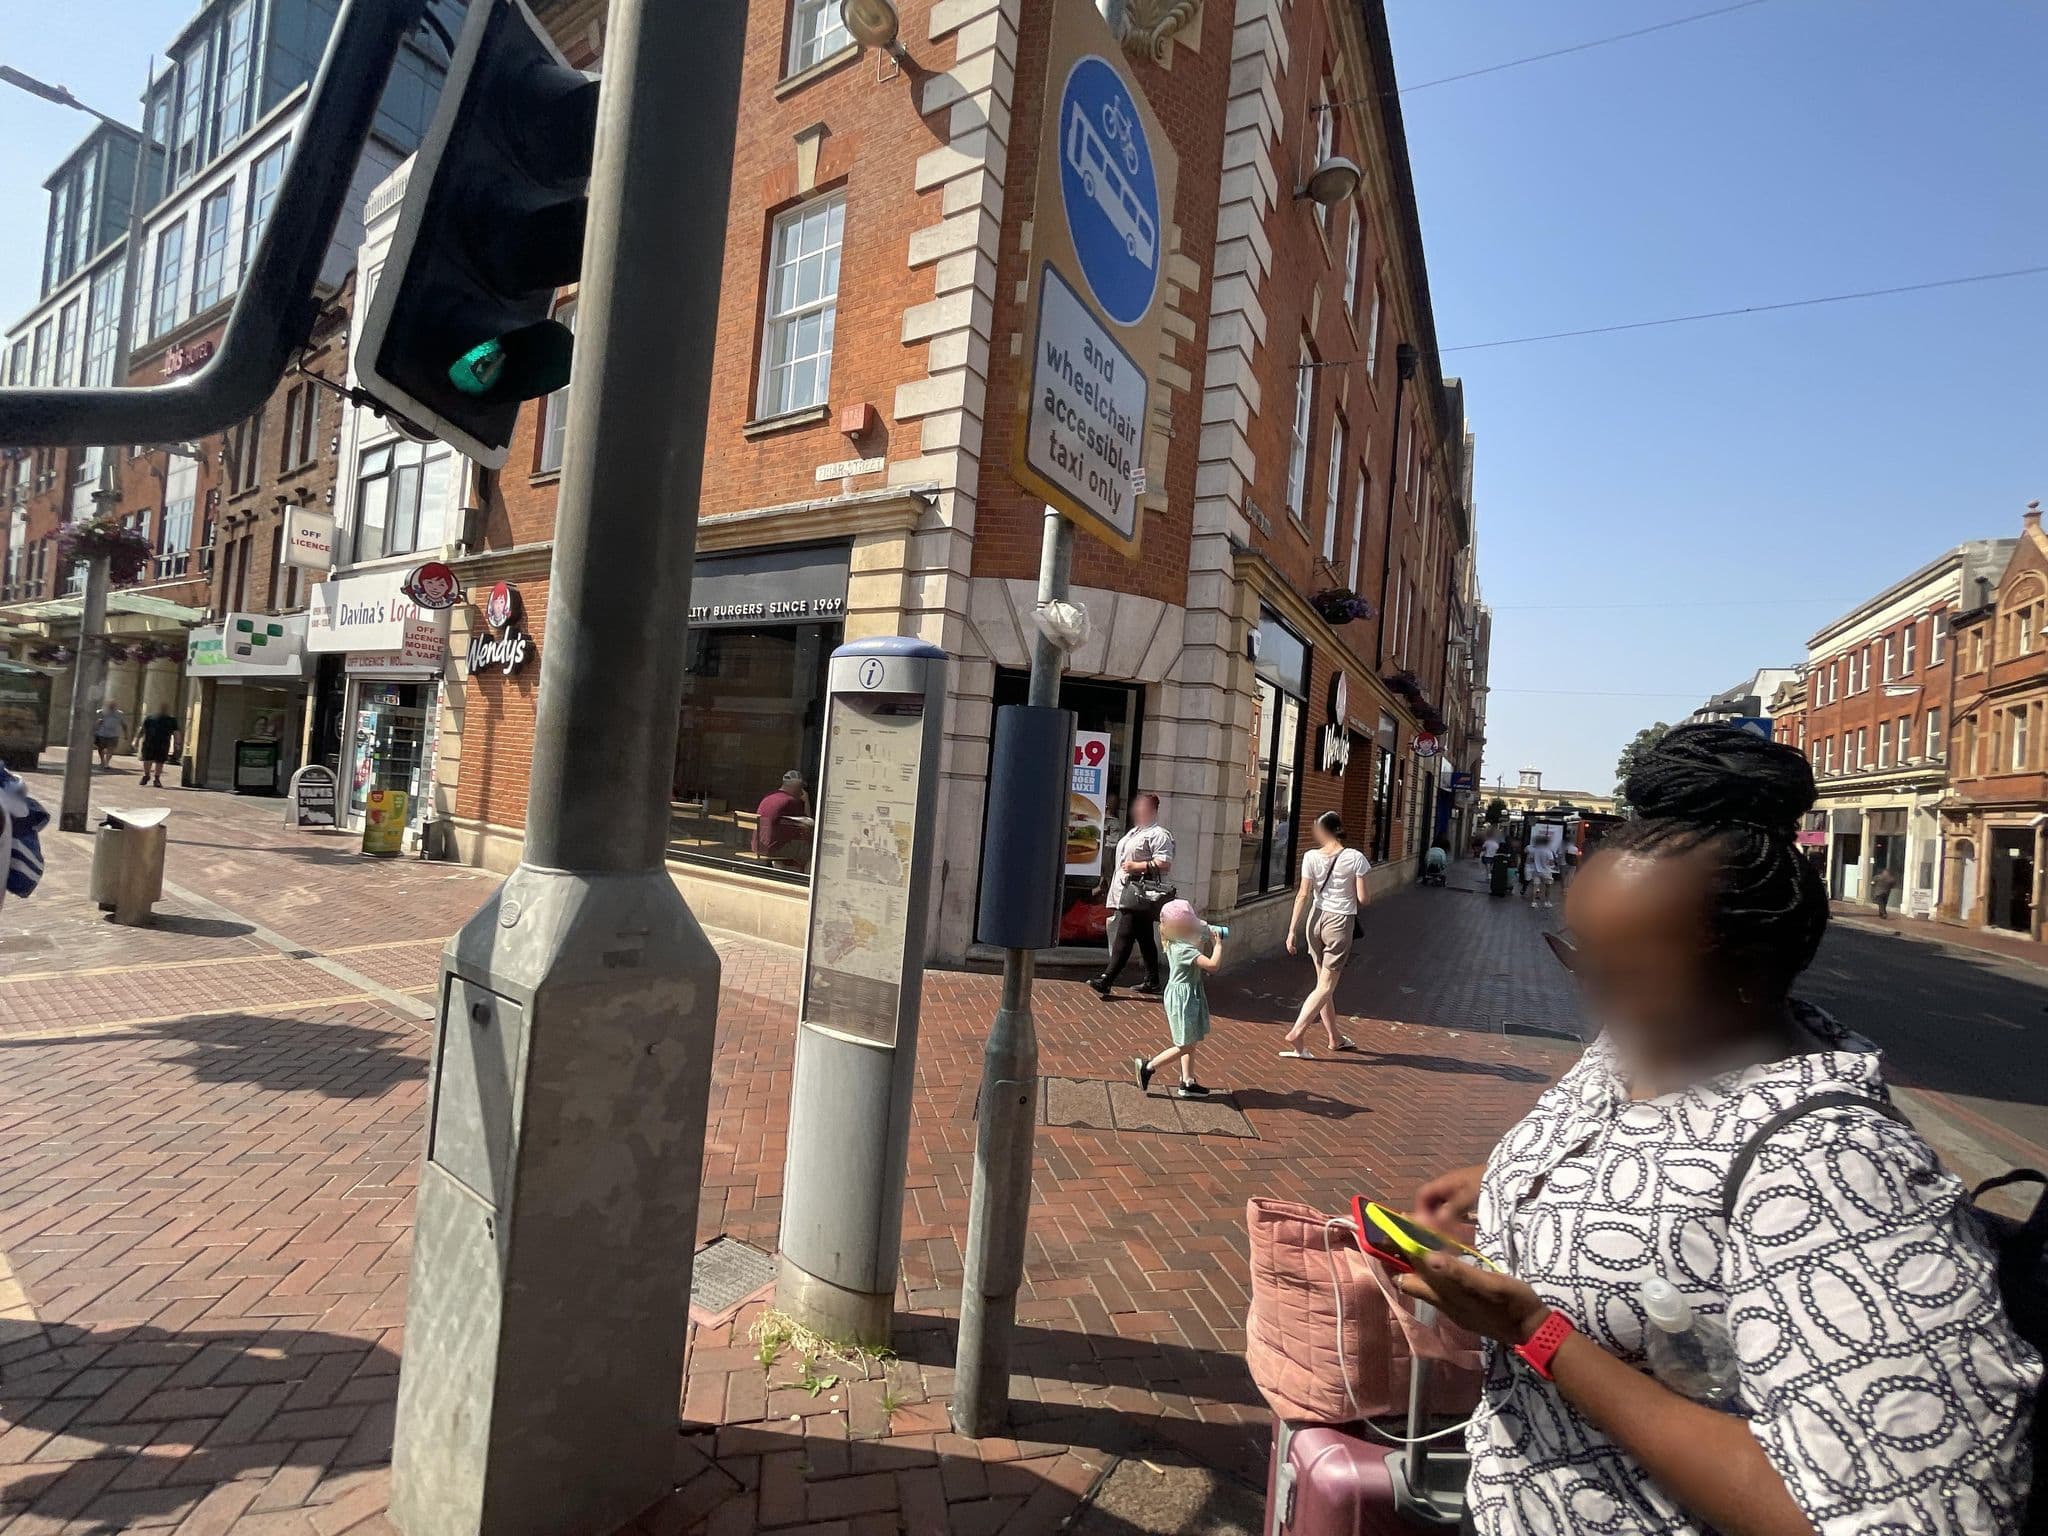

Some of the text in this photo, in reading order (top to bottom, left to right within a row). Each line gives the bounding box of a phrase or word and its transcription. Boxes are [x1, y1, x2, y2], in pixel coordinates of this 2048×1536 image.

[1084, 337, 1115, 383] and
[1046, 340, 1137, 447] wheelchair
[1044, 386, 1131, 481] accessible
[1049, 429, 1122, 515] taxi only
[301, 529, 321, 538] OFF
[290, 537, 332, 552] LICENCE
[340, 601, 385, 626] Davina's
[713, 602, 763, 616] BURGERS
[769, 600, 807, 613] SINCE
[813, 598, 842, 611] 1969
[405, 632, 445, 644] LICENCE
[417, 625, 435, 634] OFF
[405, 641, 444, 653] MOBILE
[416, 651, 442, 660] VAPE
[467, 625, 526, 675] Wendy's
